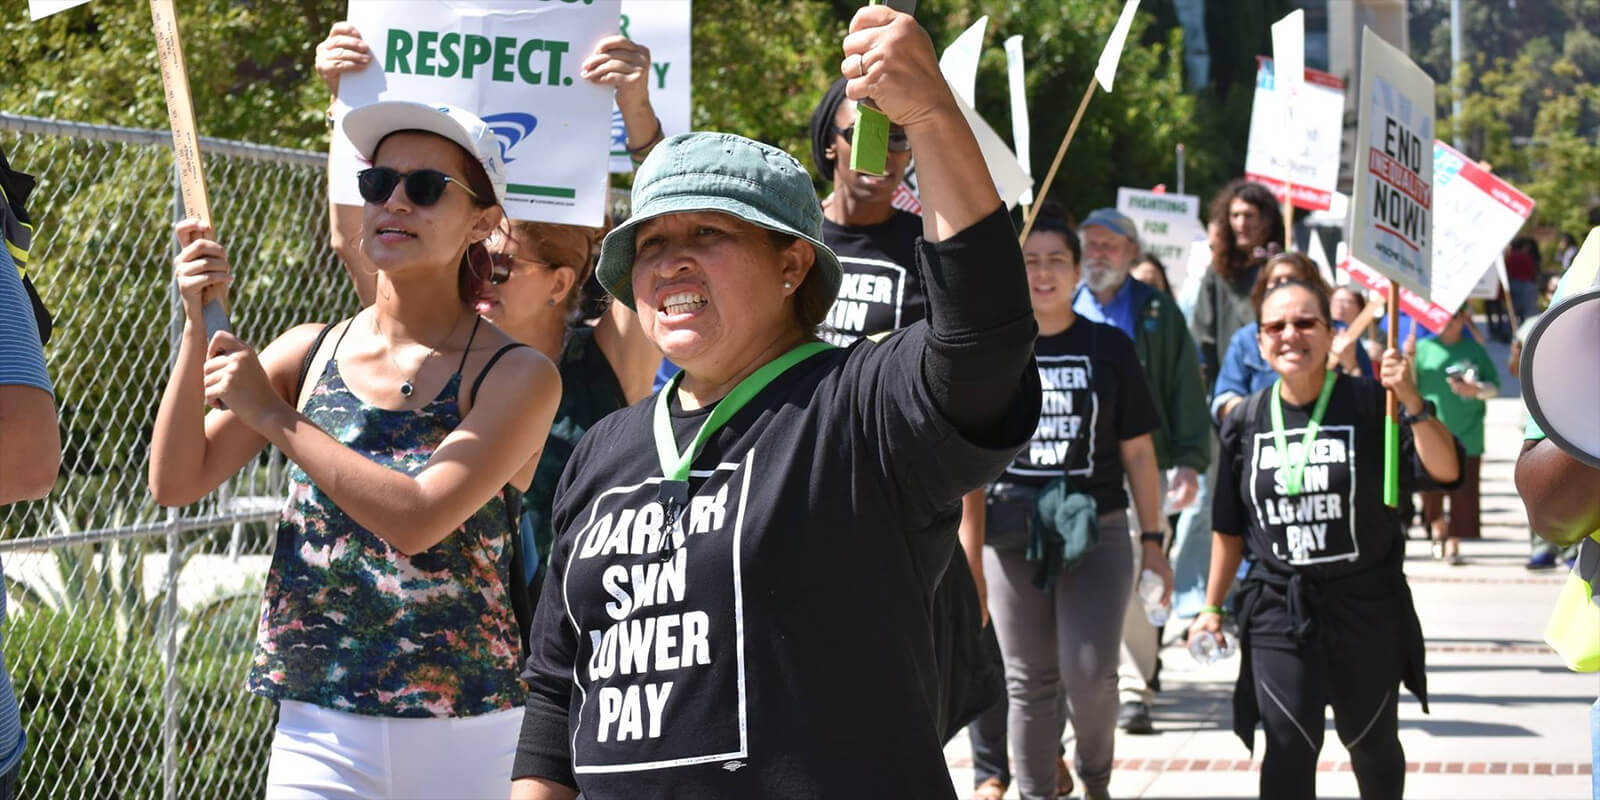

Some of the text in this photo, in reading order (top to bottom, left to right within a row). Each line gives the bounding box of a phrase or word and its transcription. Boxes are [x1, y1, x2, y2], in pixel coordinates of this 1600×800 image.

[384, 28, 574, 87] RESPECT.
[1385, 116, 1422, 174] END
[1128, 195, 1188, 214] FIGHTING
[1374, 179, 1425, 247] NOW!
[1143, 220, 1169, 234] FOR
[837, 273, 893, 304] KER
[825, 299, 869, 332] IN
[1029, 441, 1070, 466] PAY
[1274, 464, 1329, 496] SIN
[1286, 522, 1327, 552] PAY
[589, 610, 711, 681] LOWER
[597, 681, 674, 743] PAY
